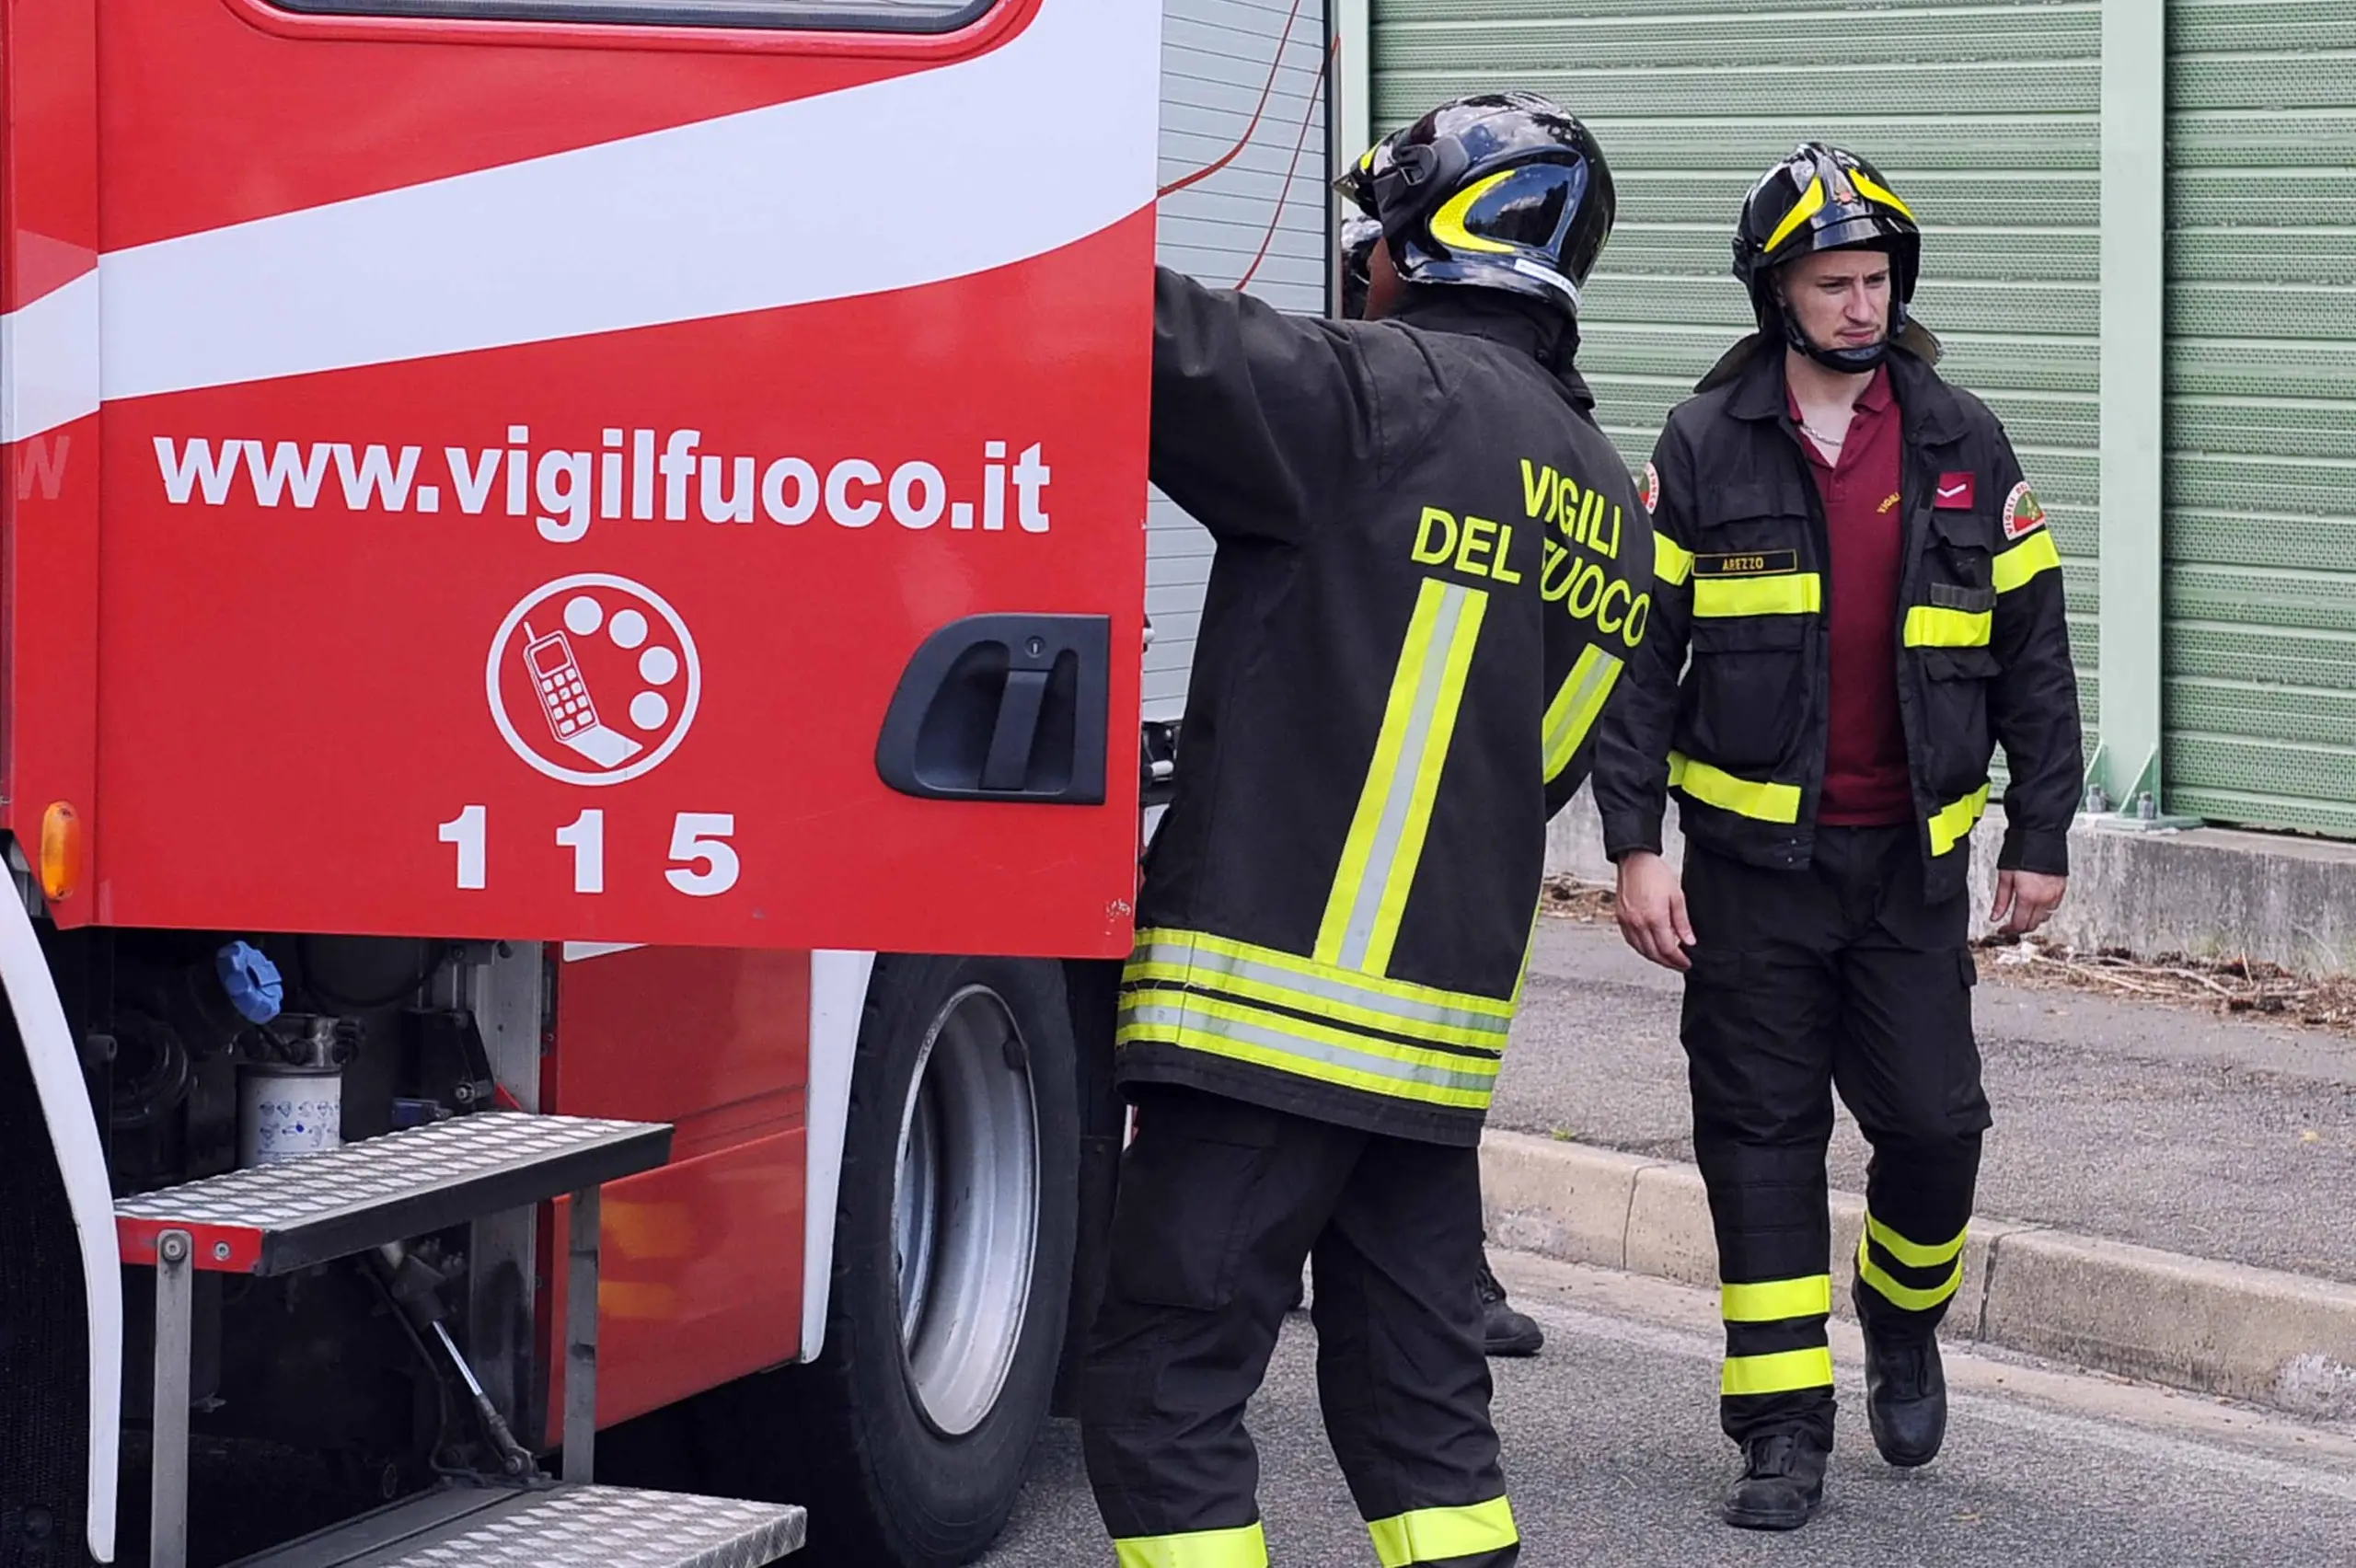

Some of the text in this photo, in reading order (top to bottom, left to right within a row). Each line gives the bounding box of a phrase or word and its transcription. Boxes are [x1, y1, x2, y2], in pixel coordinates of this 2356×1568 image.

[153, 426, 1051, 542] www.vigilfuoco.it
[1521, 459, 1623, 559] VIGILI
[1411, 506, 1521, 585] DEL
